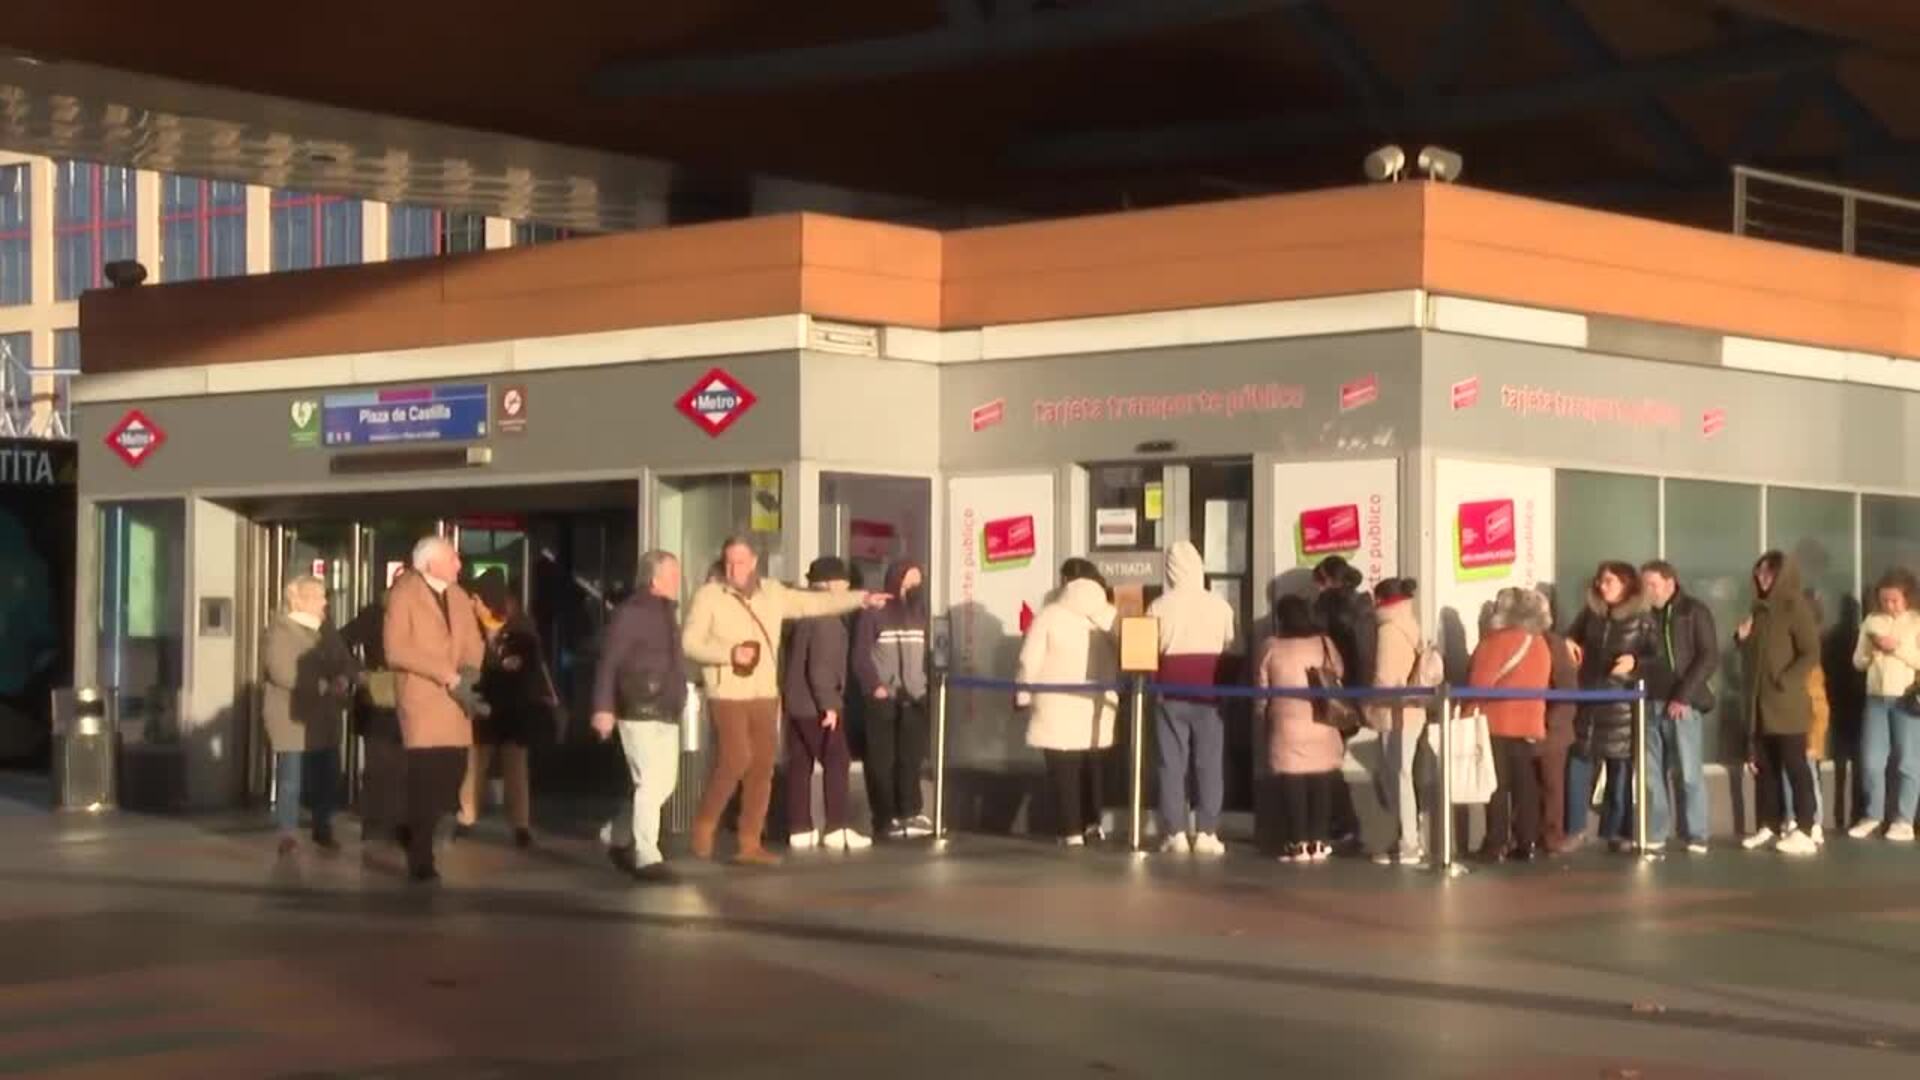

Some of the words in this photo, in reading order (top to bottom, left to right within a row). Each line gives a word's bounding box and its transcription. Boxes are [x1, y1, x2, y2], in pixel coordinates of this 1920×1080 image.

[697, 394, 735, 411] Metro
[1033, 396, 1104, 425] tarjeta
[359, 408, 390, 423] Plaza
[392, 407, 406, 422] de
[408, 403, 452, 421] Castilla
